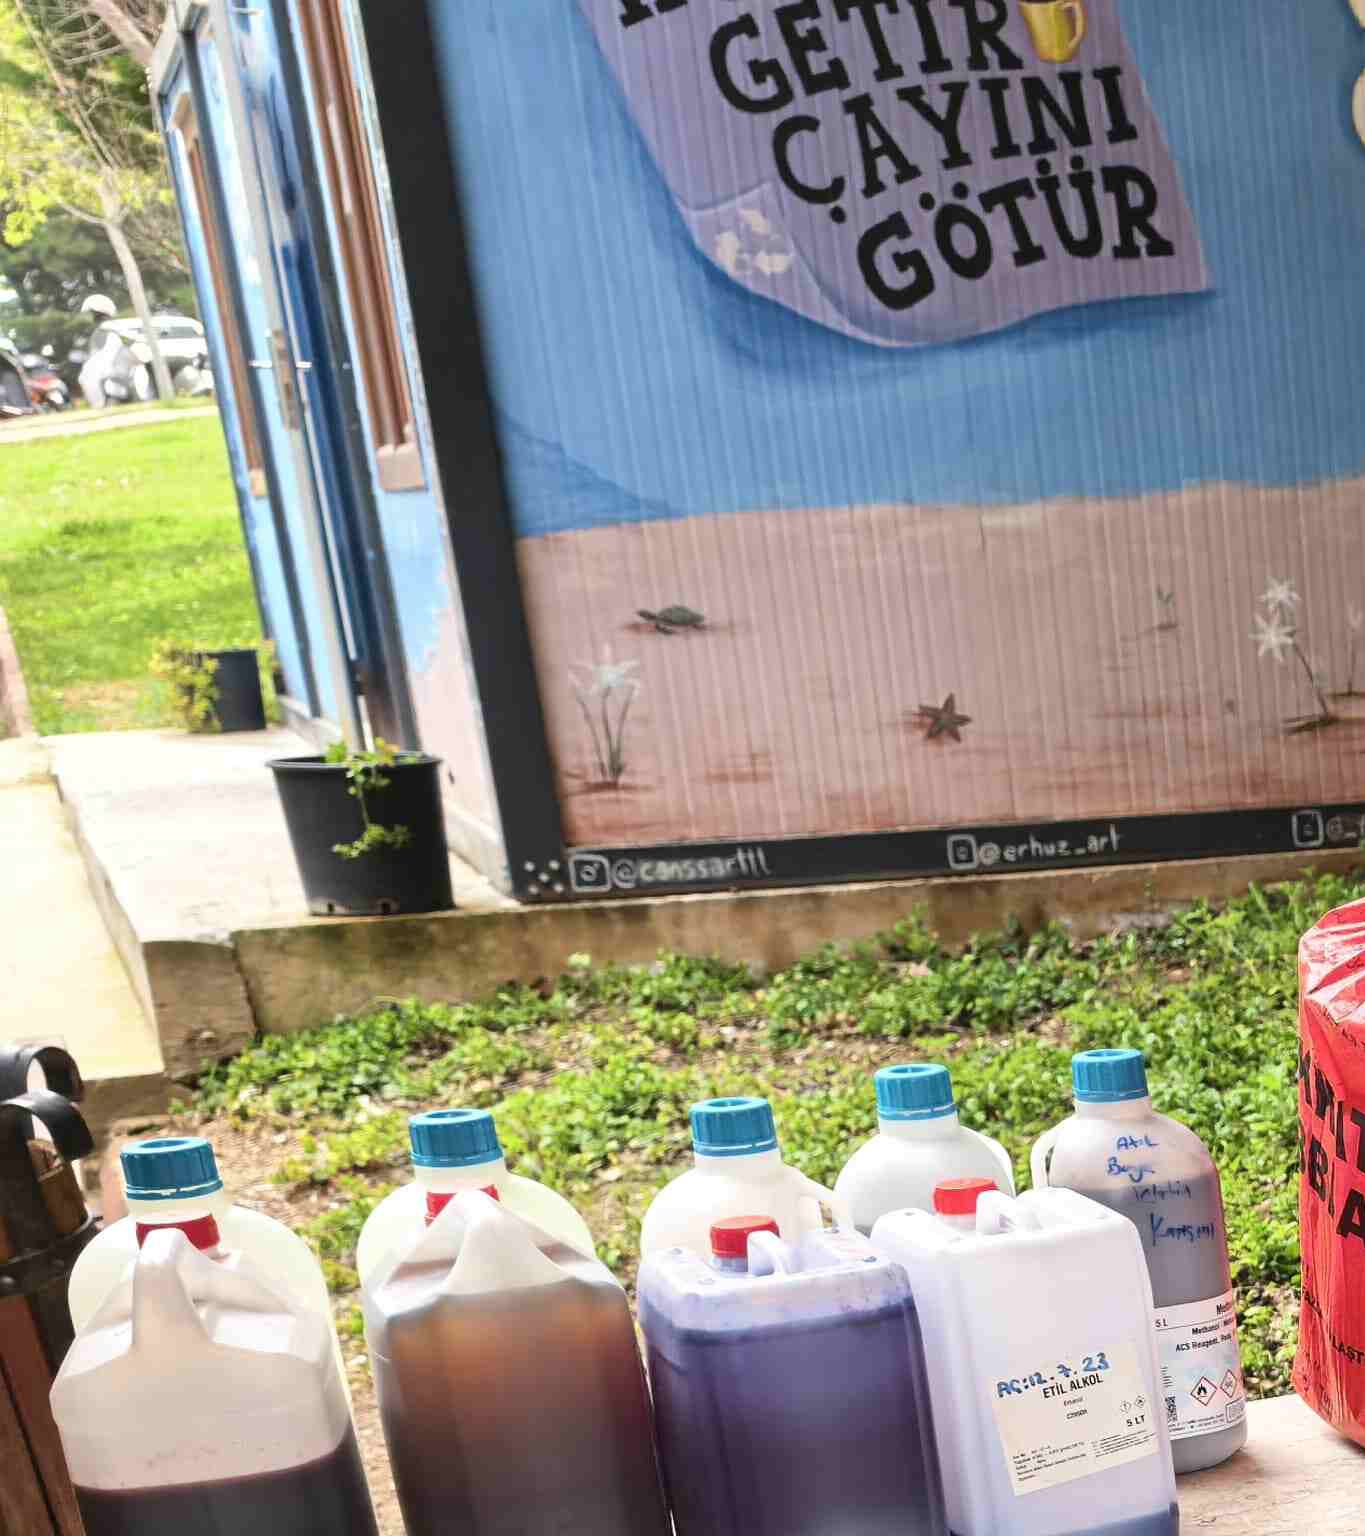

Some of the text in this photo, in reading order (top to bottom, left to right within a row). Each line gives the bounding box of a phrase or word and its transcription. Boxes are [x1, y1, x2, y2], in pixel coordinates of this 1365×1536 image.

[771, 67, 1138, 223] ÇAYINI
[857, 155, 1175, 310] GÖTÜR
[1043, 1372, 1104, 1399] ETİL ALKOL
[1176, 1342, 1191, 1352] ACS
